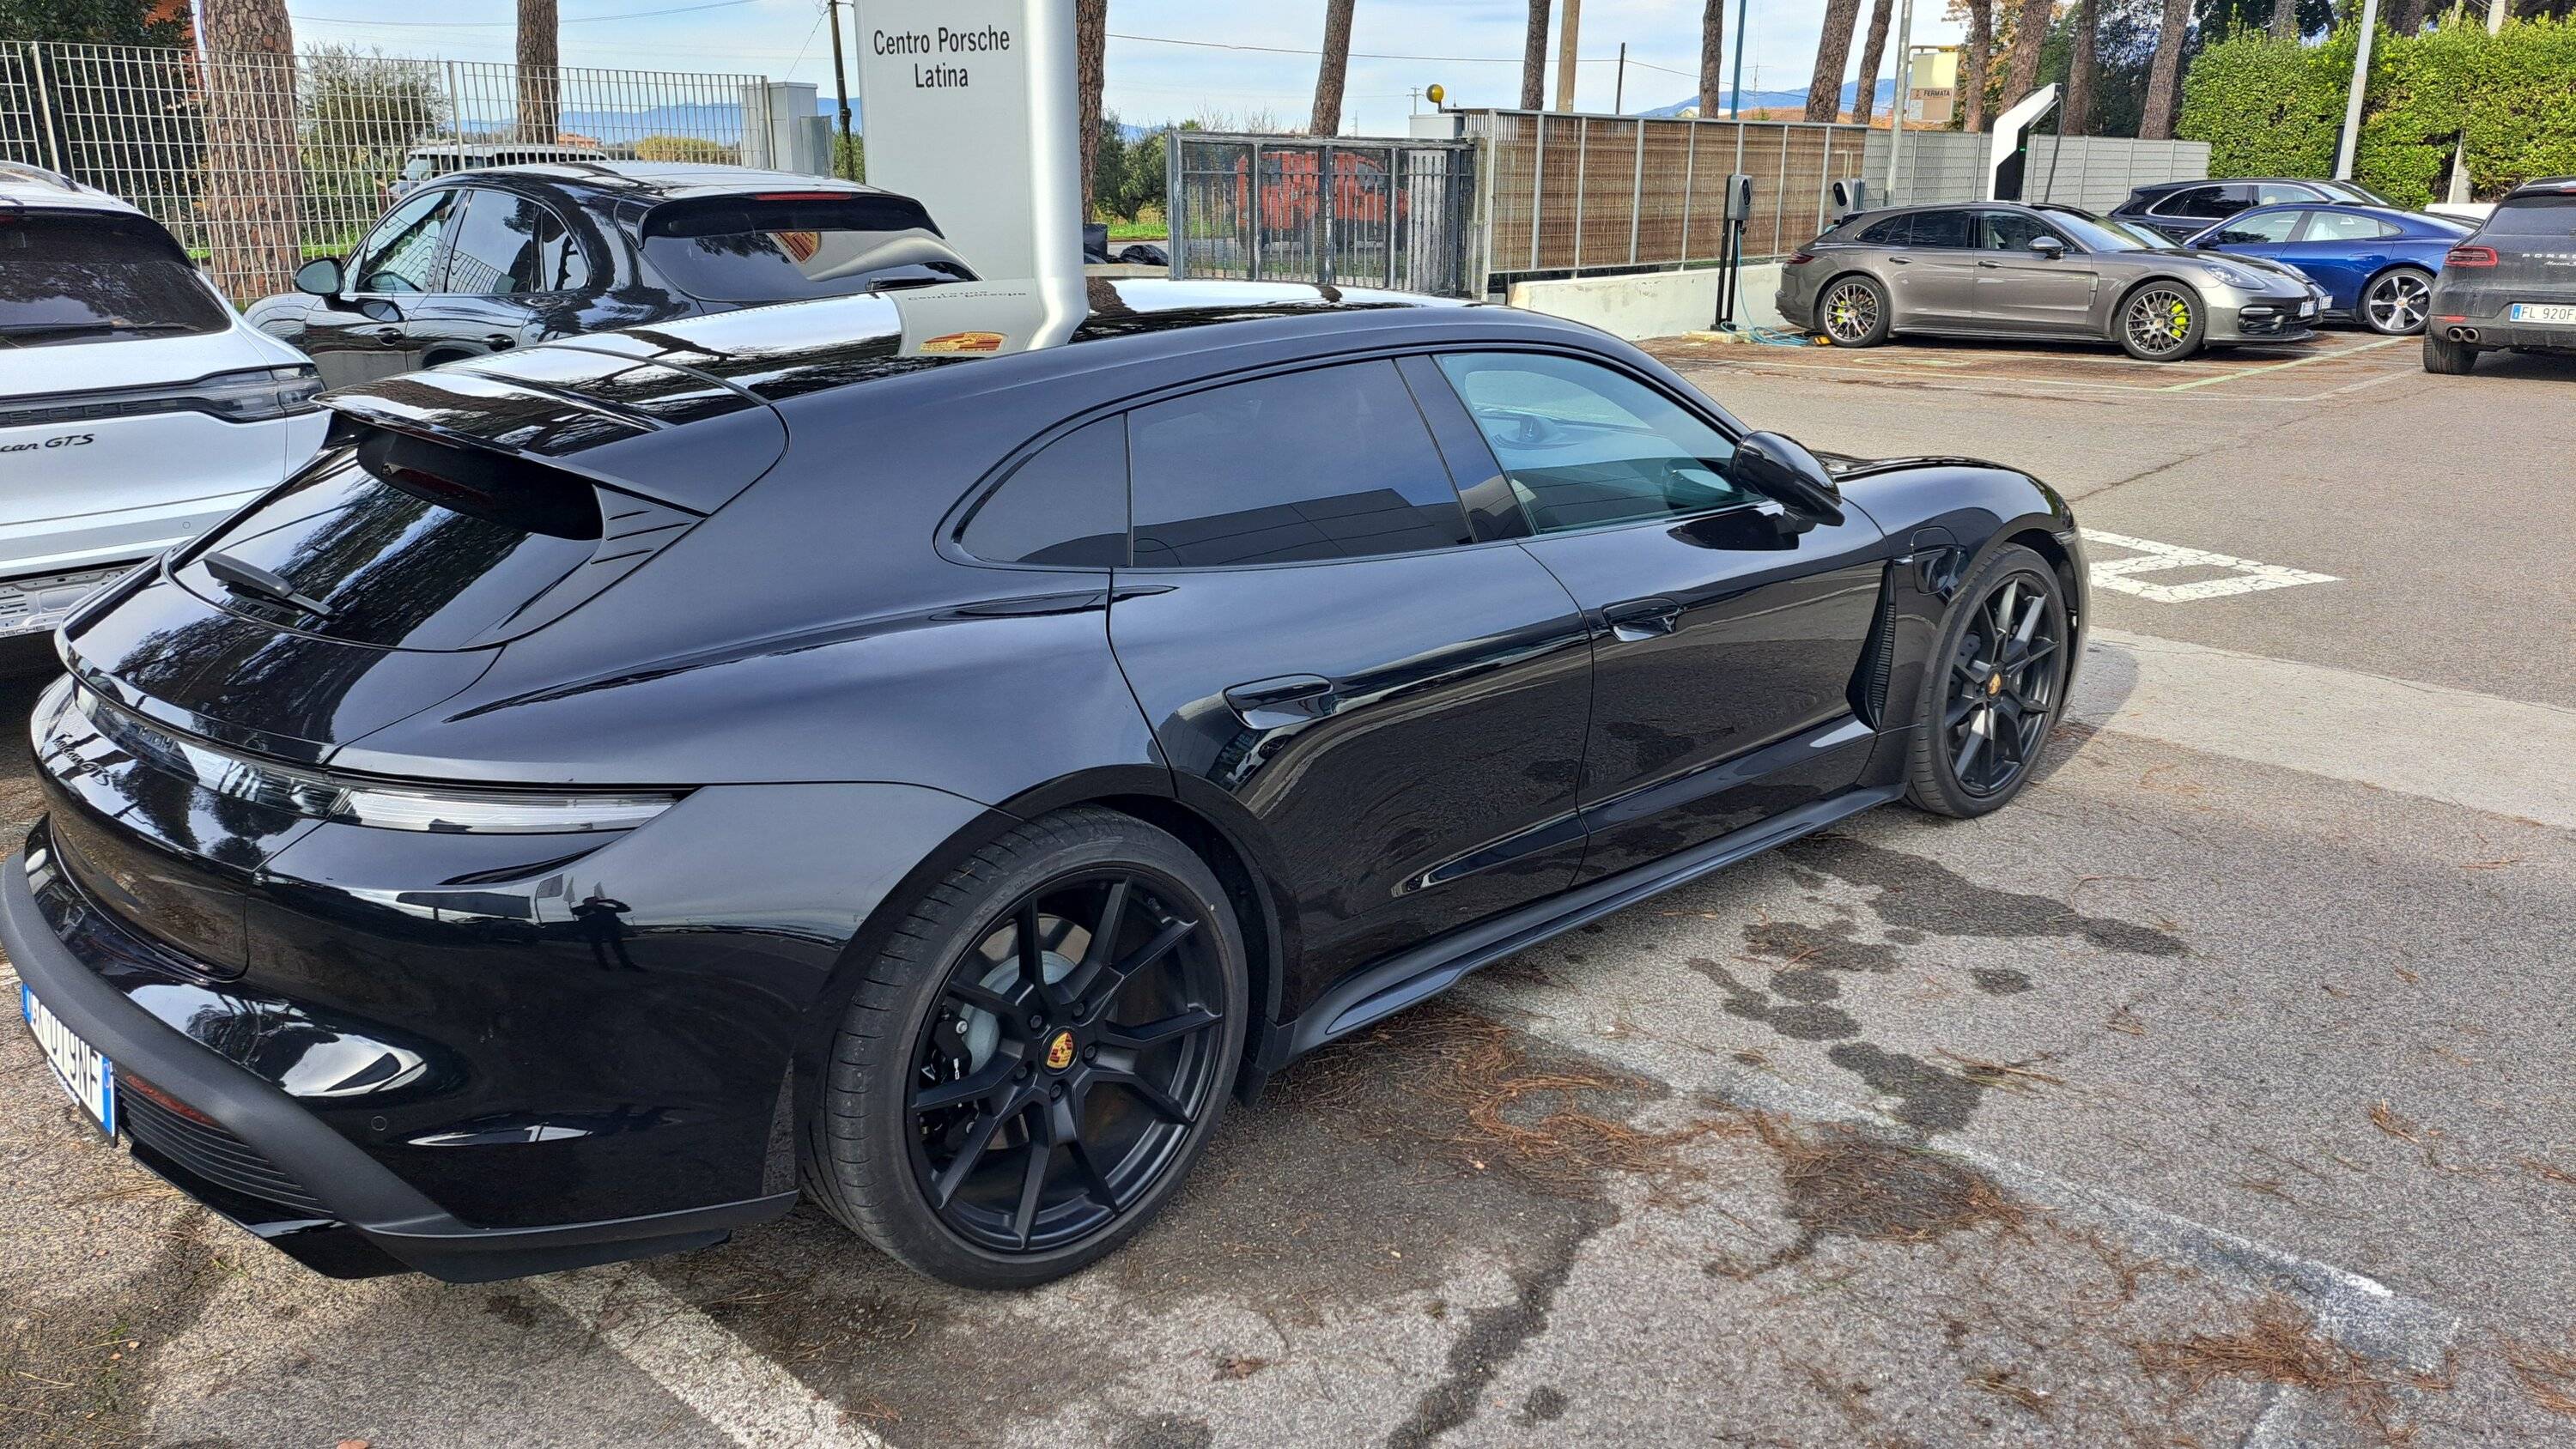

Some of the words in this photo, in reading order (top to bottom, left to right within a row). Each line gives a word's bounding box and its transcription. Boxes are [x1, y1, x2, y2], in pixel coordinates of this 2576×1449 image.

[873, 29, 930, 55] Centro
[938, 24, 1010, 52] Porsche
[914, 62, 969, 88] Latina
[2521, 306, 2536, 318] FL
[2543, 307, 2576, 320] 920F
[0, 443, 39, 452] can
[45, 433, 95, 448] GTS
